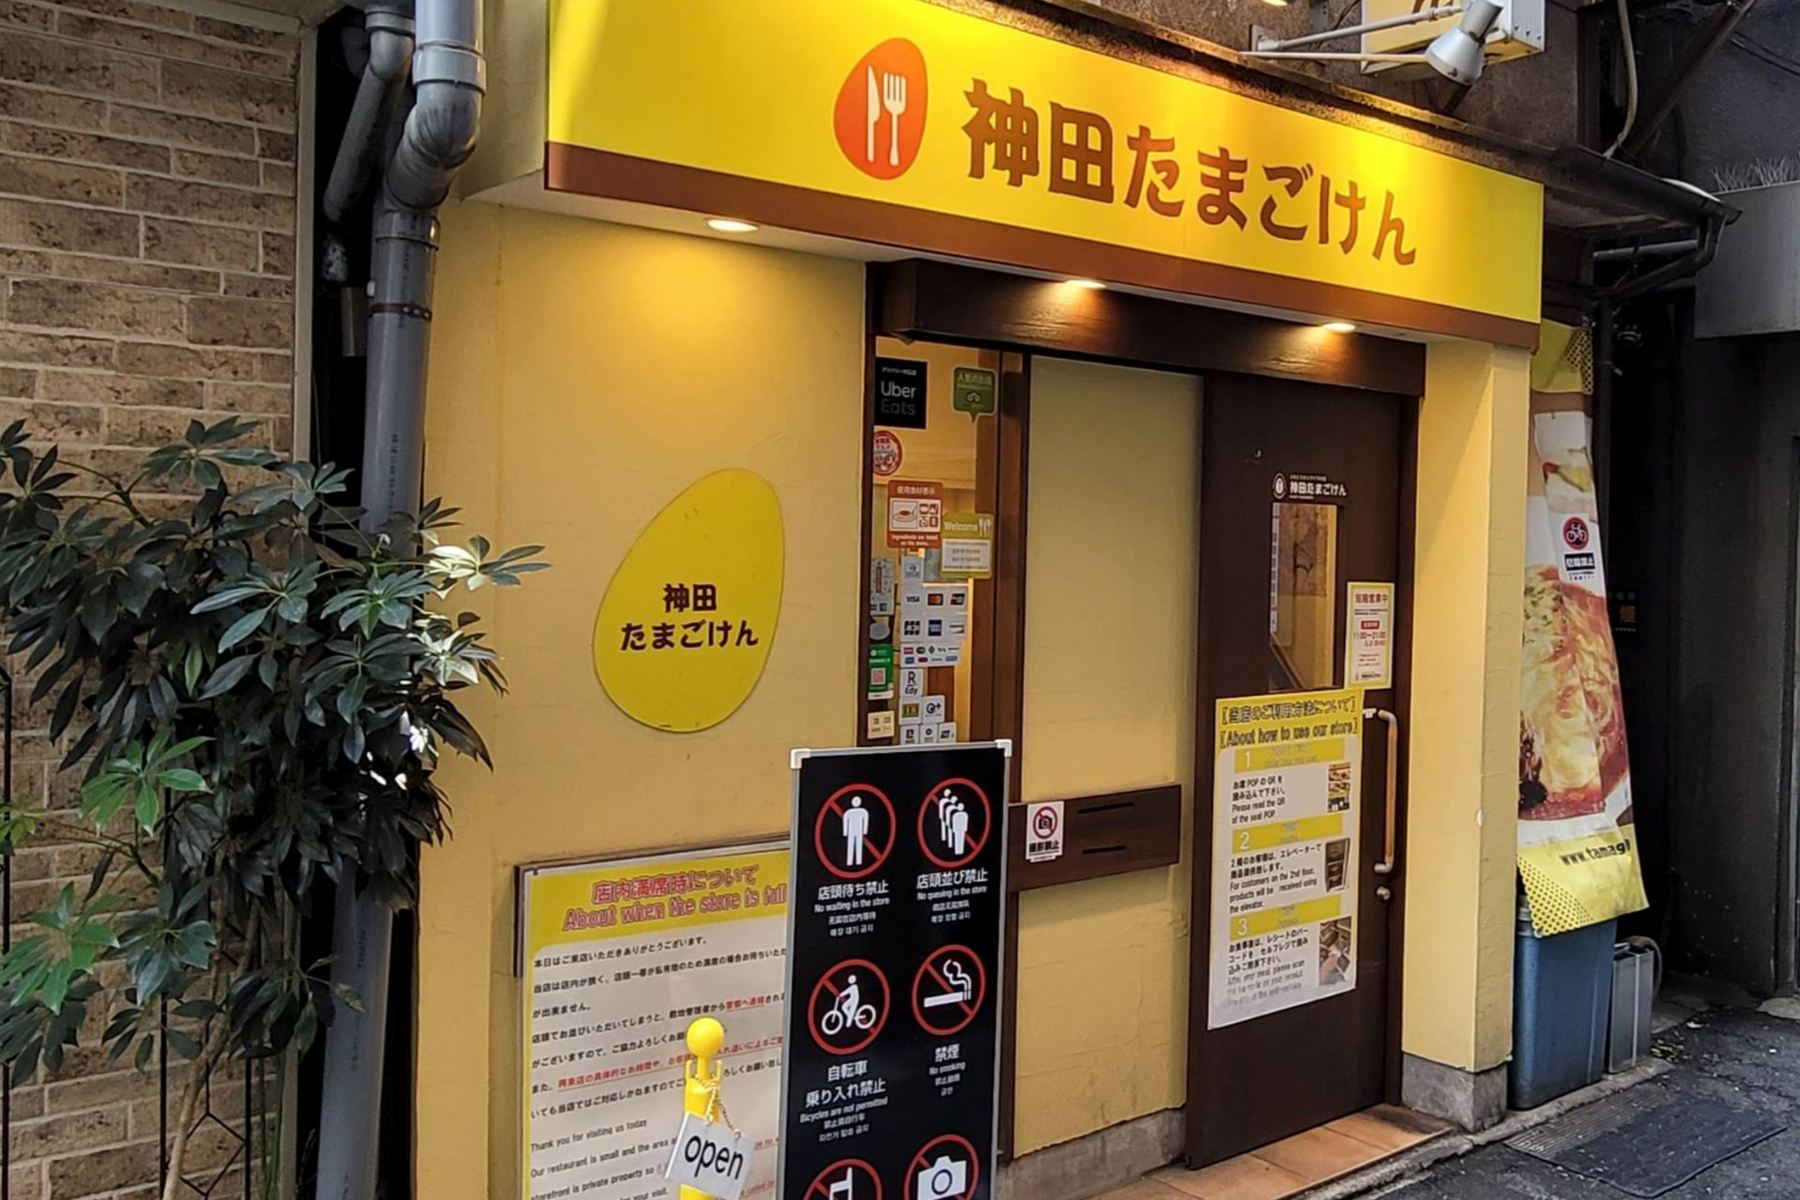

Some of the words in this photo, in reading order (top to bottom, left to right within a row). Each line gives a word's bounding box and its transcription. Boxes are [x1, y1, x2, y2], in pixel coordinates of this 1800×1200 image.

[962, 77, 1418, 266] 神田たまごけん
[881, 380, 916, 399] Uber
[881, 398, 916, 416] Eats
[1290, 481, 1347, 497] 神田たまごけん
[944, 521, 979, 531] Welcome
[663, 583, 717, 613] 神田
[905, 595, 920, 603] VISA
[621, 619, 759, 651] たまごけん
[1259, 727, 1278, 744] how
[1281, 726, 1290, 741] to
[1293, 726, 1310, 740] use
[1313, 724, 1327, 737] our
[1245, 749, 1250, 769] 1
[1232, 803, 1251, 813] Please
[1252, 799, 1265, 810] read
[1266, 799, 1276, 808] the
[1231, 815, 1238, 824] of
[1239, 814, 1248, 823] the
[1264, 809, 1276, 819] POP
[1240, 831, 1250, 850] 2
[593, 865, 759, 904] 店内満席時について
[916, 867, 988, 889] 店頭並び禁止
[1230, 881, 1240, 891] For
[1241, 877, 1269, 889] customers
[1280, 872, 1288, 881] the
[1290, 868, 1300, 879] 2nd
[818, 879, 889, 900] 店頭待ち禁止
[917, 892, 926, 901] No
[953, 888, 960, 896] in
[960, 887, 971, 895] the
[971, 885, 987, 894] store
[1229, 890, 1254, 903] products
[1256, 887, 1265, 897] will
[1266, 886, 1274, 895] be
[1279, 880, 1302, 892] received
[1303, 878, 1317, 889] using
[563, 905, 618, 931] About
[622, 902, 665, 924] when
[669, 896, 695, 917] the
[700, 890, 741, 914] store
[744, 887, 759, 908] is
[765, 883, 787, 905] full
[814, 903, 824, 913] No
[825, 901, 851, 911] waiting
[852, 900, 859, 908] in
[860, 899, 871, 907] the
[872, 897, 890, 906] store
[1229, 904, 1238, 914] the
[1237, 917, 1247, 936] 3
[935, 1043, 960, 1063] 禁煙
[828, 1060, 868, 1082] 自転車
[929, 1066, 939, 1075] No
[939, 1061, 966, 1073] smoking
[805, 1077, 886, 1108] 乗り入れ禁止
[800, 1110, 829, 1124] Bicycles
[830, 1107, 842, 1116] are
[843, 1103, 855, 1113] not
[855, 1096, 888, 1112] permitted
[530, 1140, 554, 1153] Thank
[556, 1136, 570, 1148] you
[572, 1133, 583, 1144] for
[586, 1127, 613, 1140] visiting
[615, 1124, 624, 1132] us
[627, 1119, 647, 1131] today
[530, 1166, 545, 1178] Our
[548, 1154, 587, 1174] restaurant
[590, 1152, 597, 1164] is
[599, 1148, 620, 1163] small
[622, 1145, 636, 1157] and
[638, 1142, 650, 1153] the
[652, 1138, 669, 1150] area
[684, 1135, 744, 1180] open
[572, 1183, 580, 1194] is
[582, 1178, 608, 1193] private
[611, 1168, 643, 1186] property
[645, 1166, 655, 1175] so
